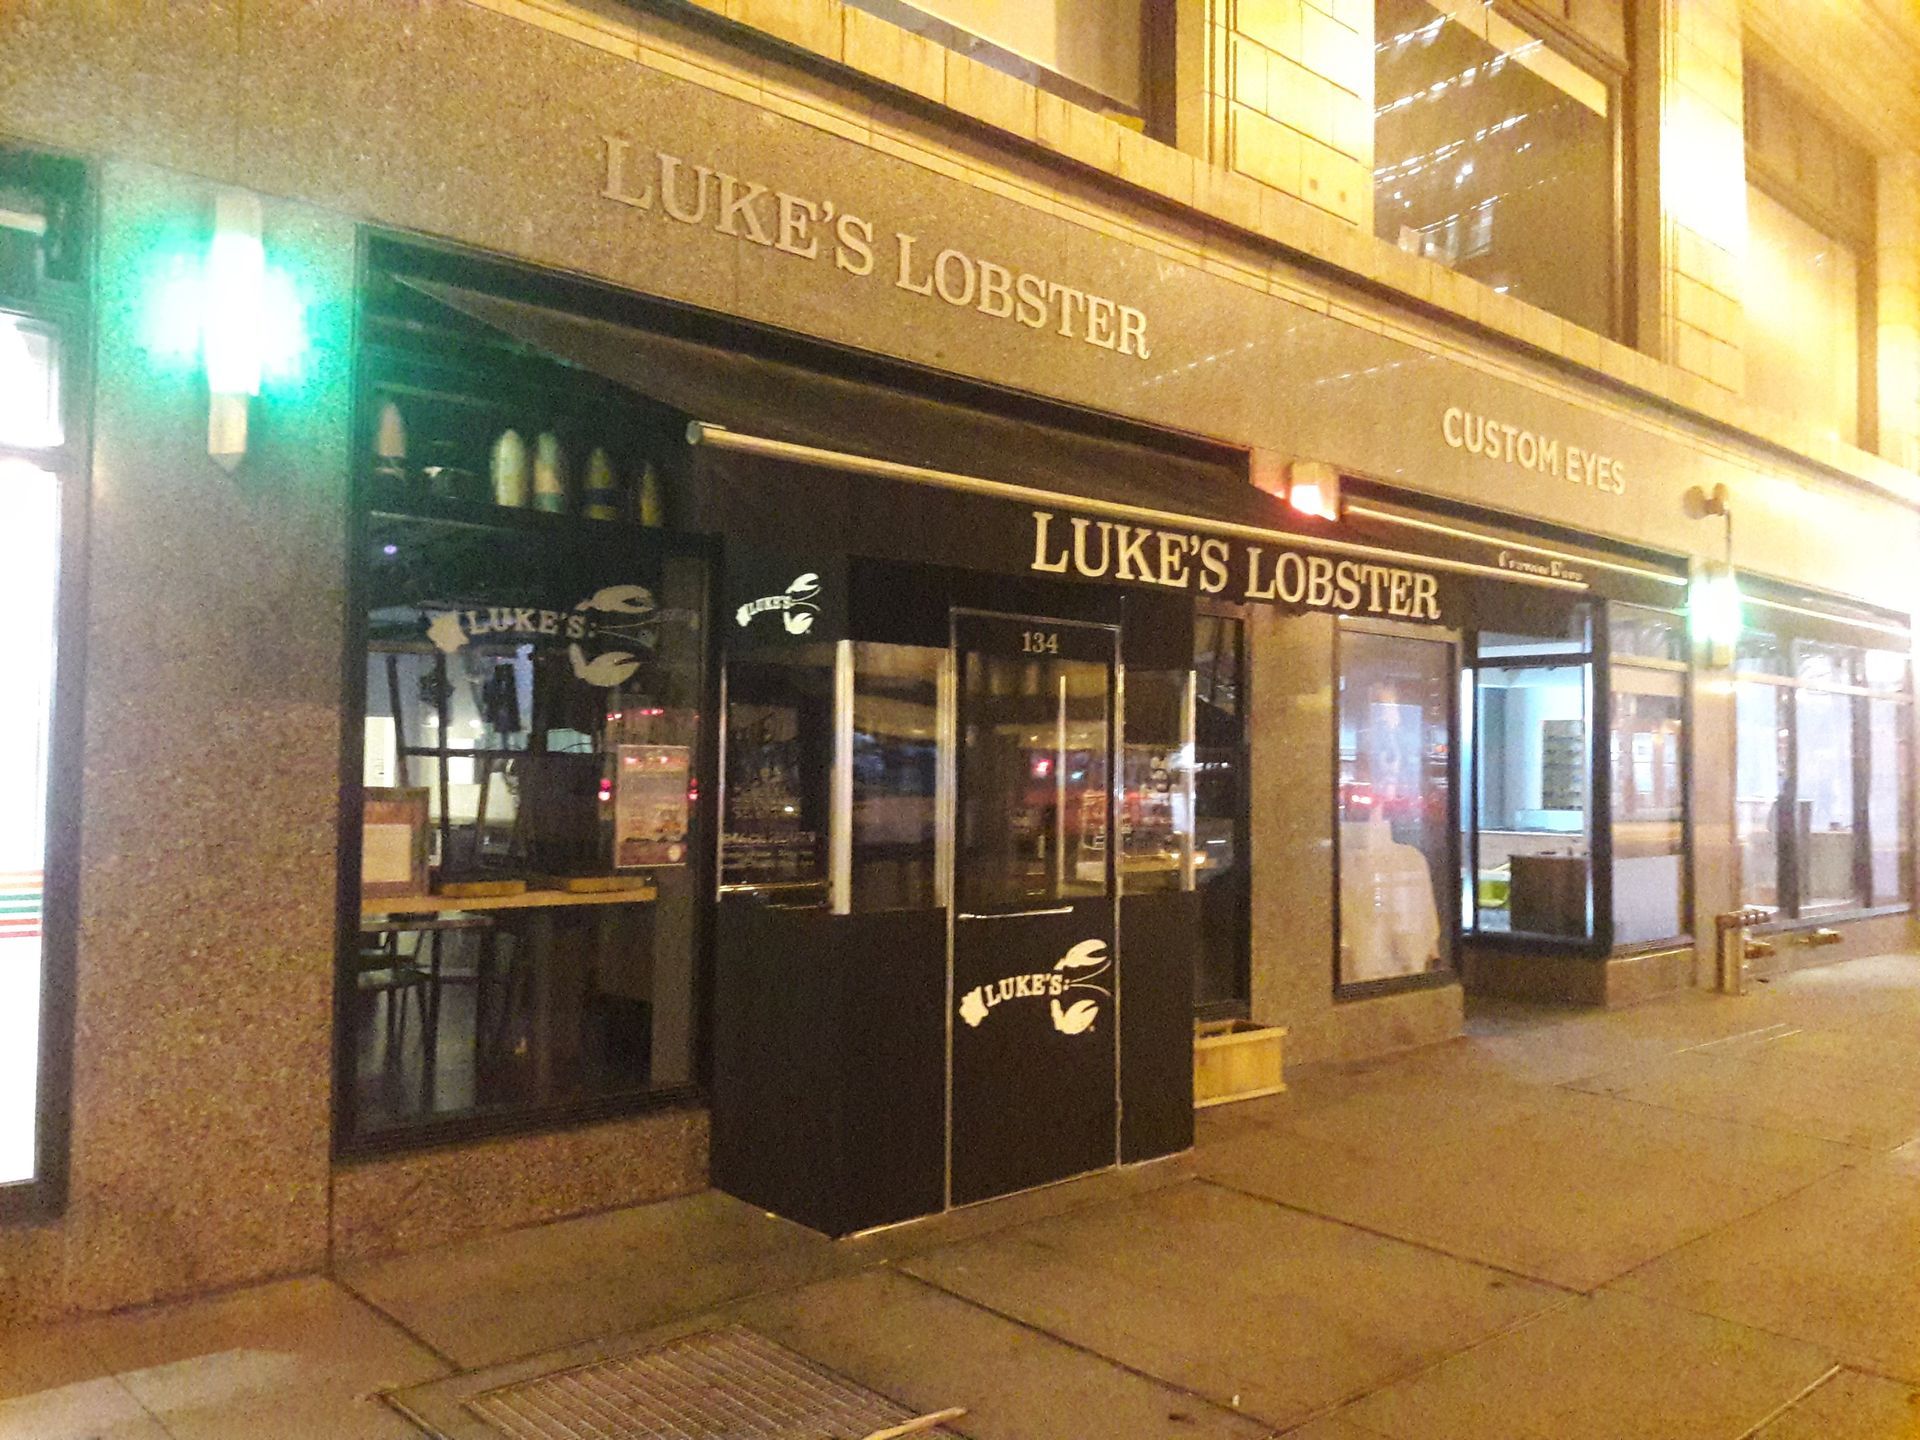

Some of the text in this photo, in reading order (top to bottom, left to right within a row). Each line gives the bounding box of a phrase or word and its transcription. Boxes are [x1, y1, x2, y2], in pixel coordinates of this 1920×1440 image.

[601, 134, 1151, 361] LUKE'S LOBSTER
[1442, 406, 1627, 496] CUSTOM EYES
[1030, 510, 1230, 594] LUKE'S
[1245, 547, 1442, 621] LOBSTER
[465, 607, 586, 639] LUKE'S
[1022, 631, 1058, 654] 134
[984, 973, 1063, 1008] LUKE'S
